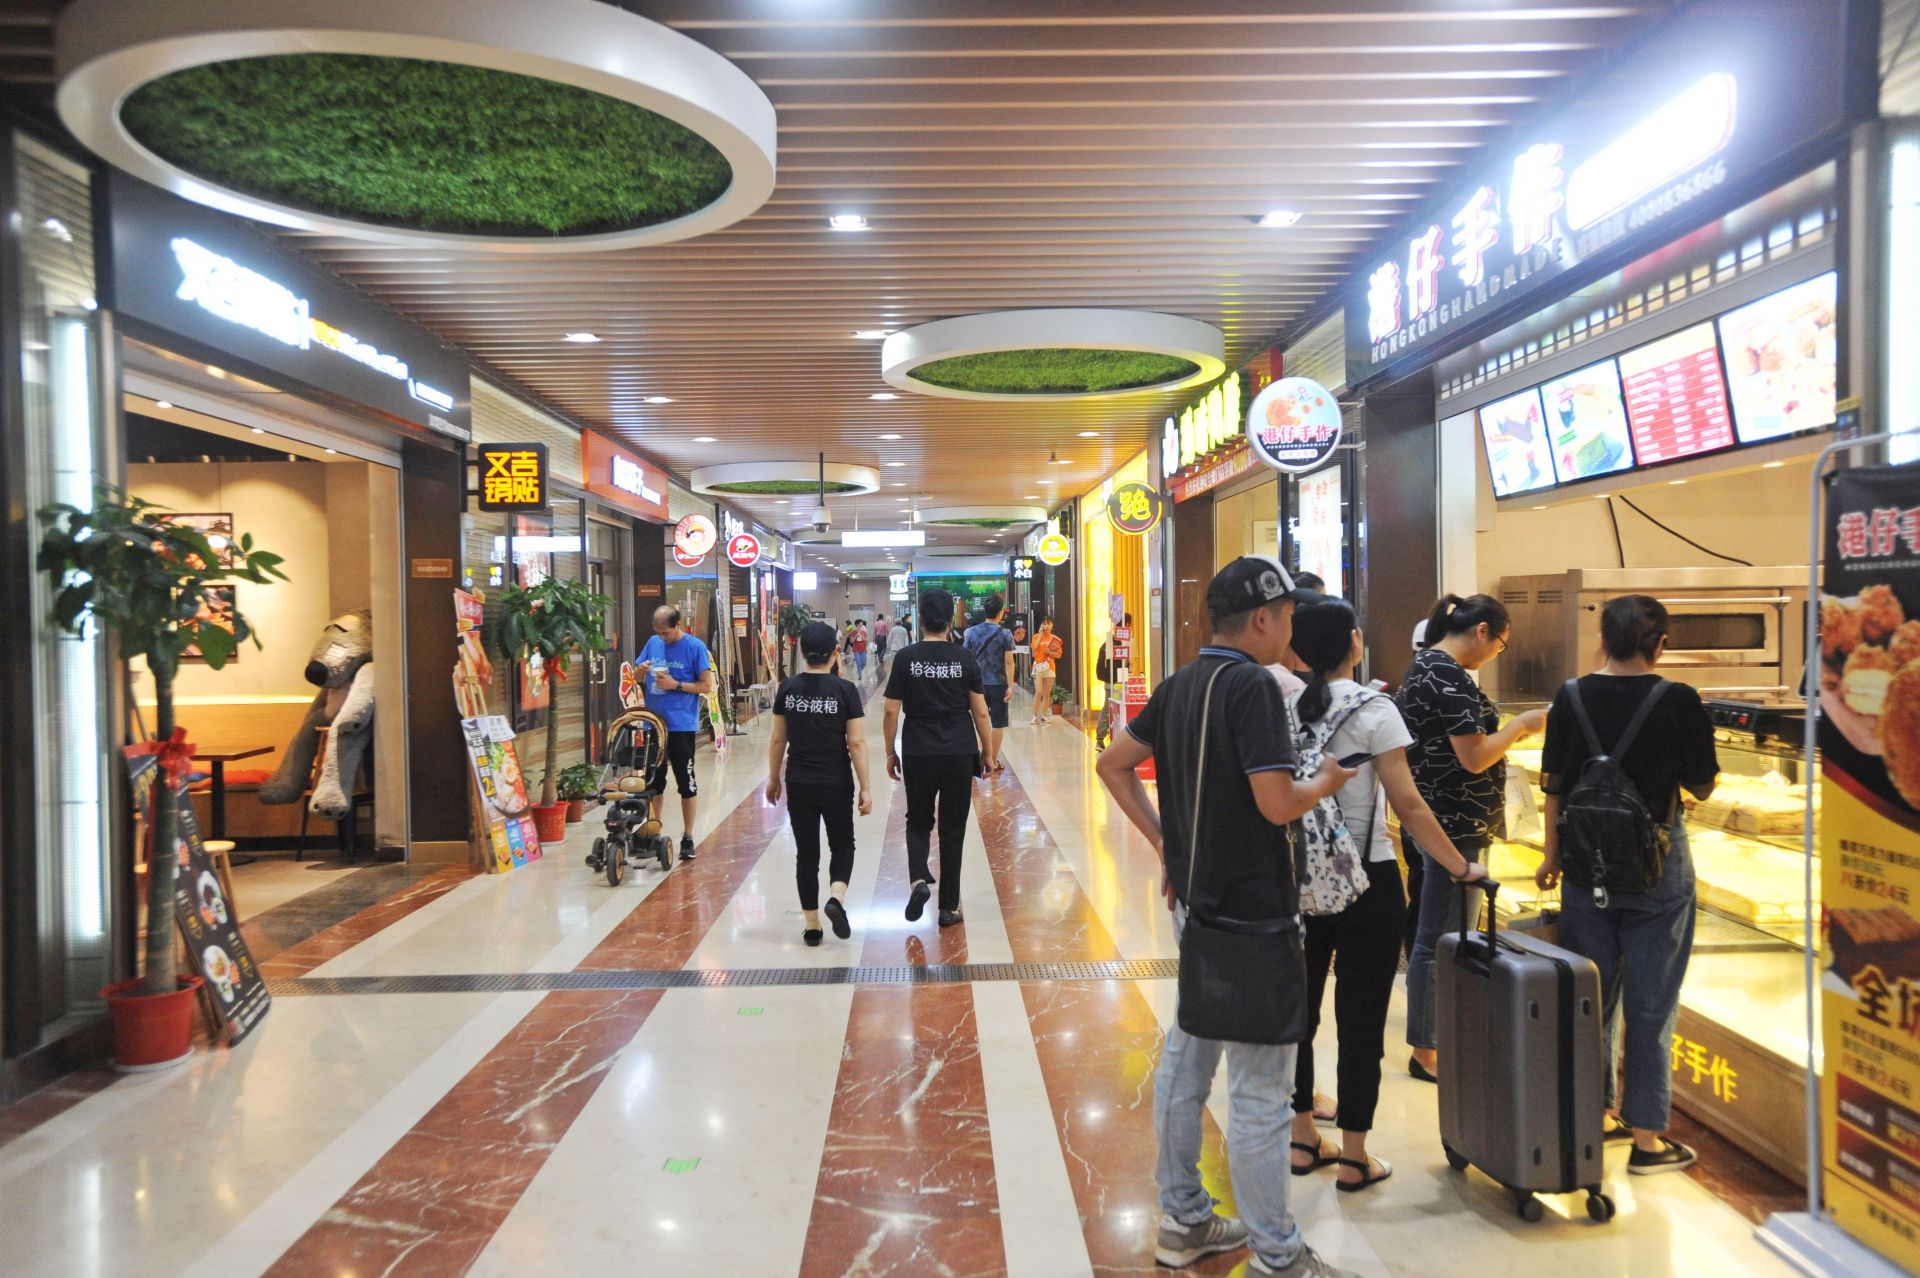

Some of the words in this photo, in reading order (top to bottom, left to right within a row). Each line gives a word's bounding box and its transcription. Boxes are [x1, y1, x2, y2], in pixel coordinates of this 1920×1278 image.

[1263, 425, 1332, 444] 港仔手作
[485, 451, 538, 476] 又吉
[485, 477, 539, 503] 锅贴
